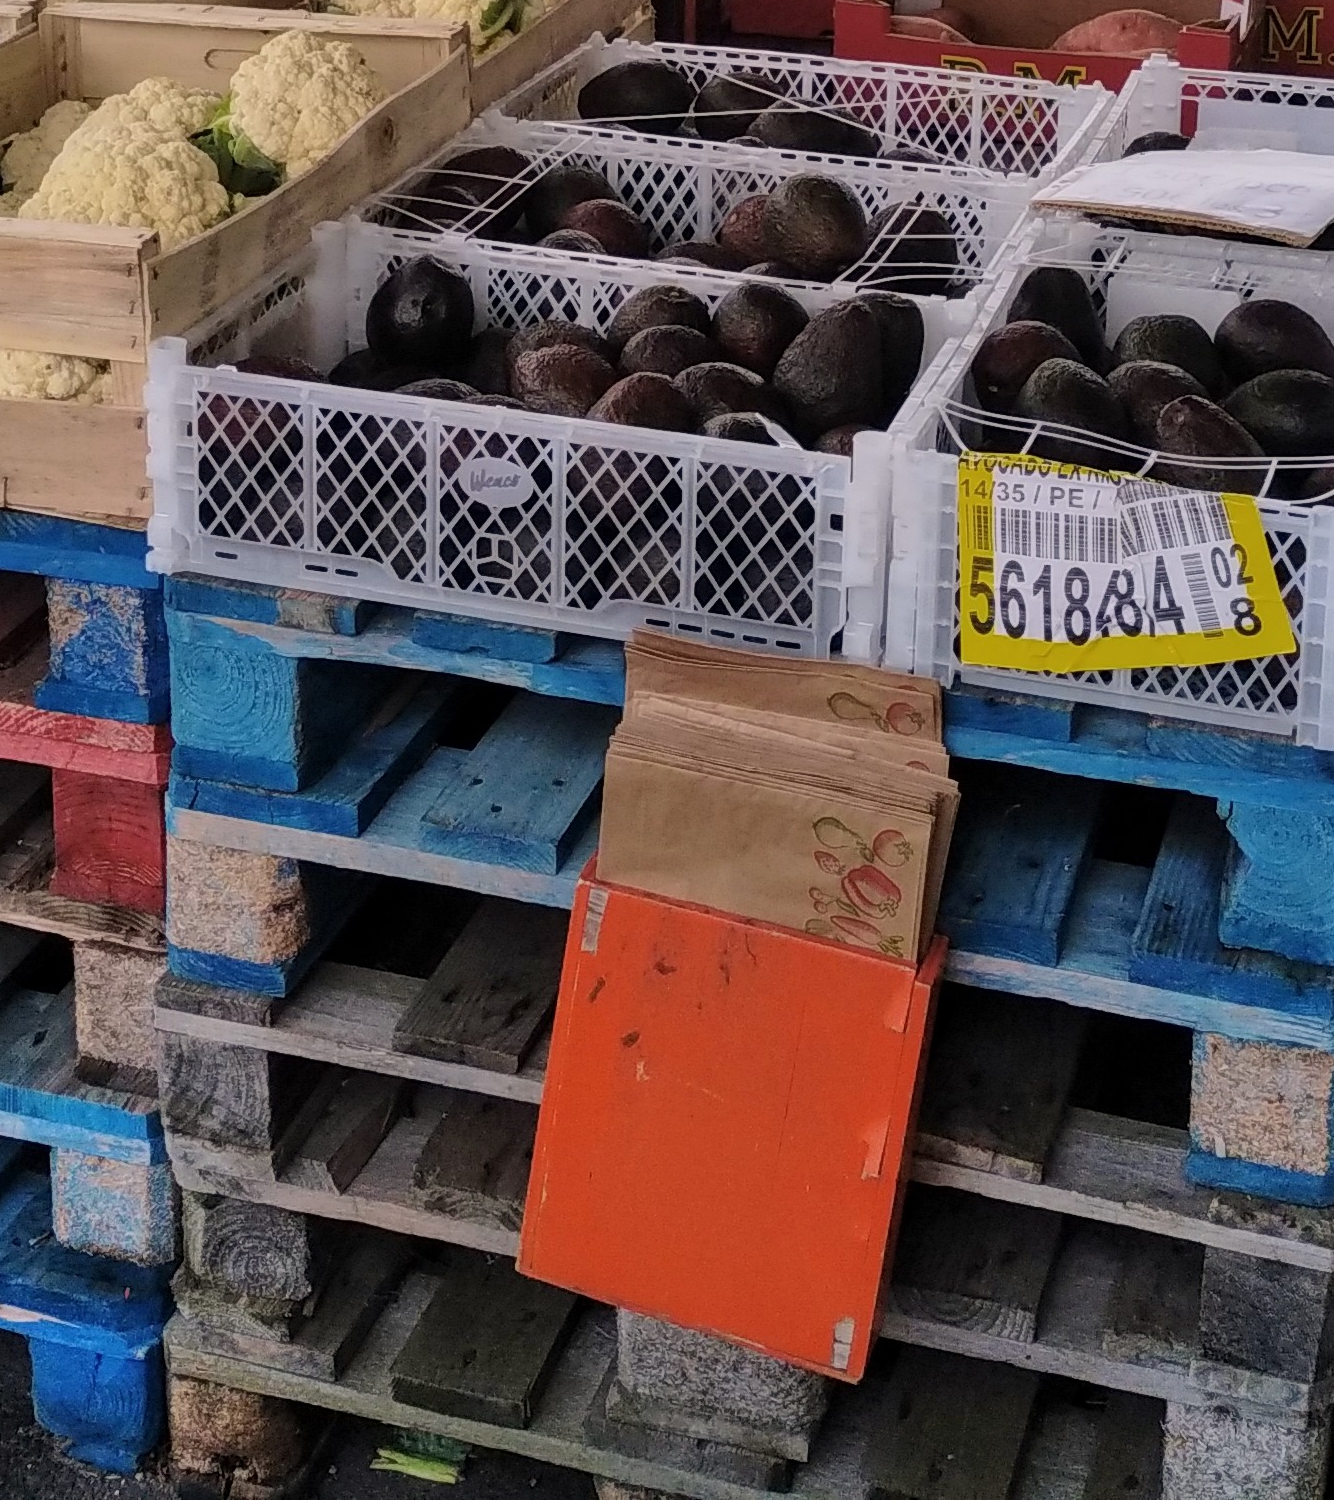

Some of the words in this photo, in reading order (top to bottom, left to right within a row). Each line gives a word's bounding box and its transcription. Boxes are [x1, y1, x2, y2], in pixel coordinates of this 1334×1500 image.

[960, 478, 1026, 504] 14/35
[1050, 486, 1085, 509] PE
[1211, 543, 1255, 589] 02
[1230, 597, 1262, 636] 8
